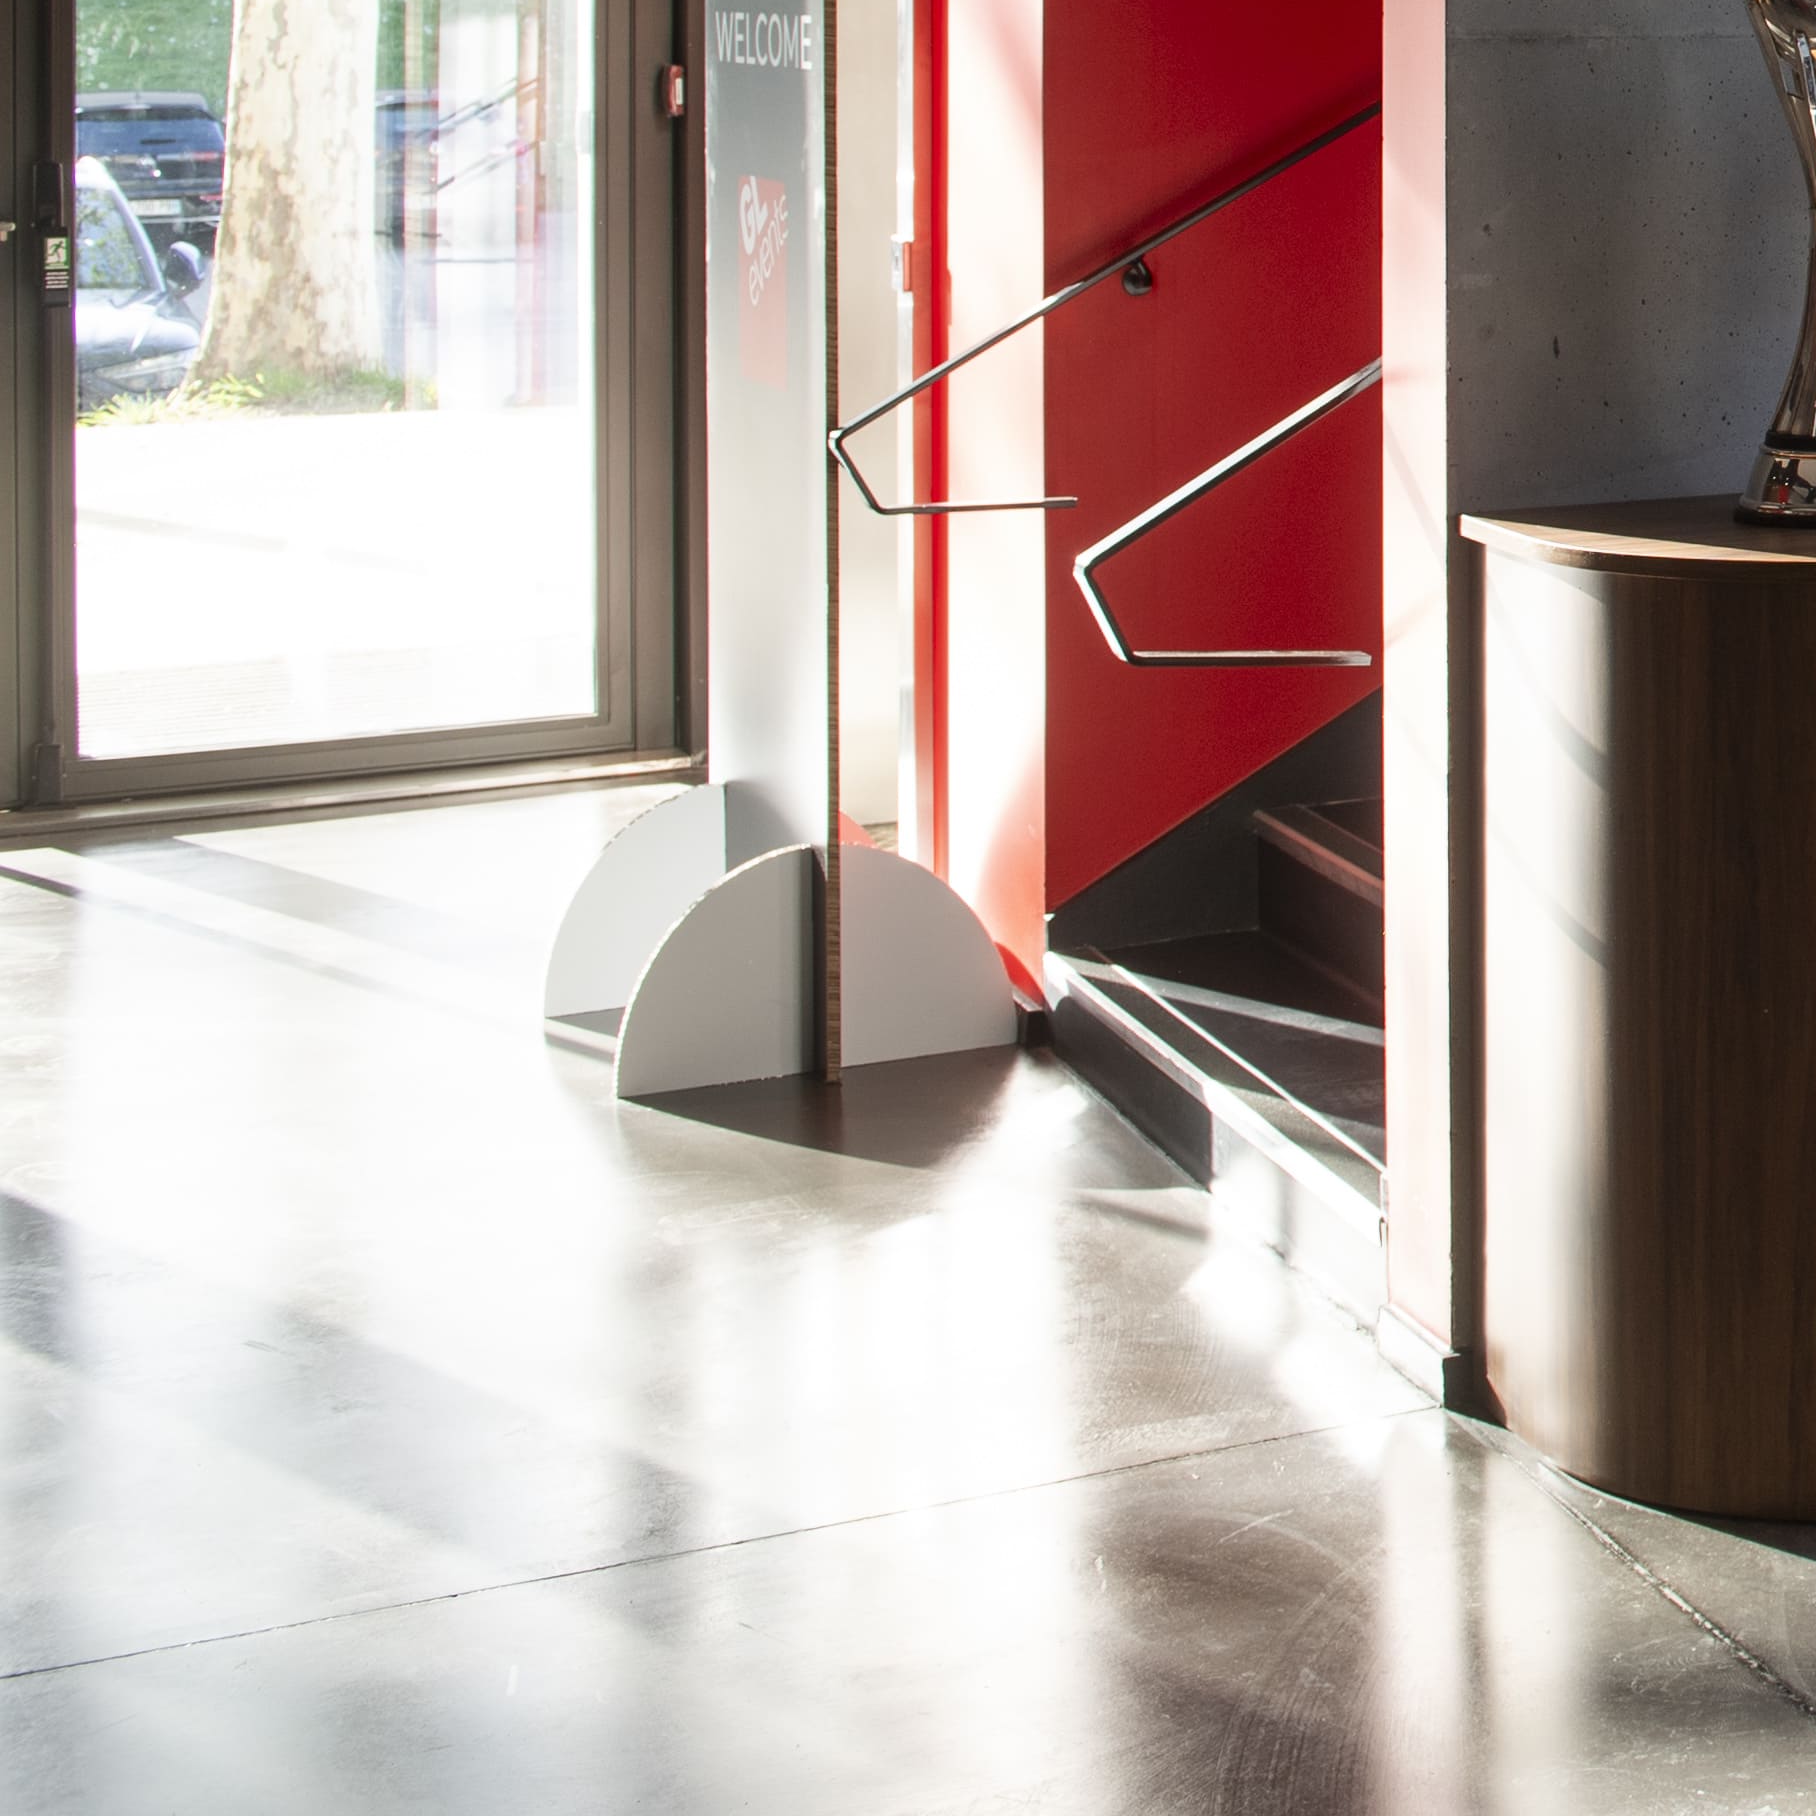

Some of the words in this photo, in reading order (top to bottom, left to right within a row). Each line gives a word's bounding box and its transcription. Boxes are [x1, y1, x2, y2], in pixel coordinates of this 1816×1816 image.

[715, 10, 813, 71] WELCOME
[739, 175, 769, 256] GL
[748, 194, 789, 307] events
